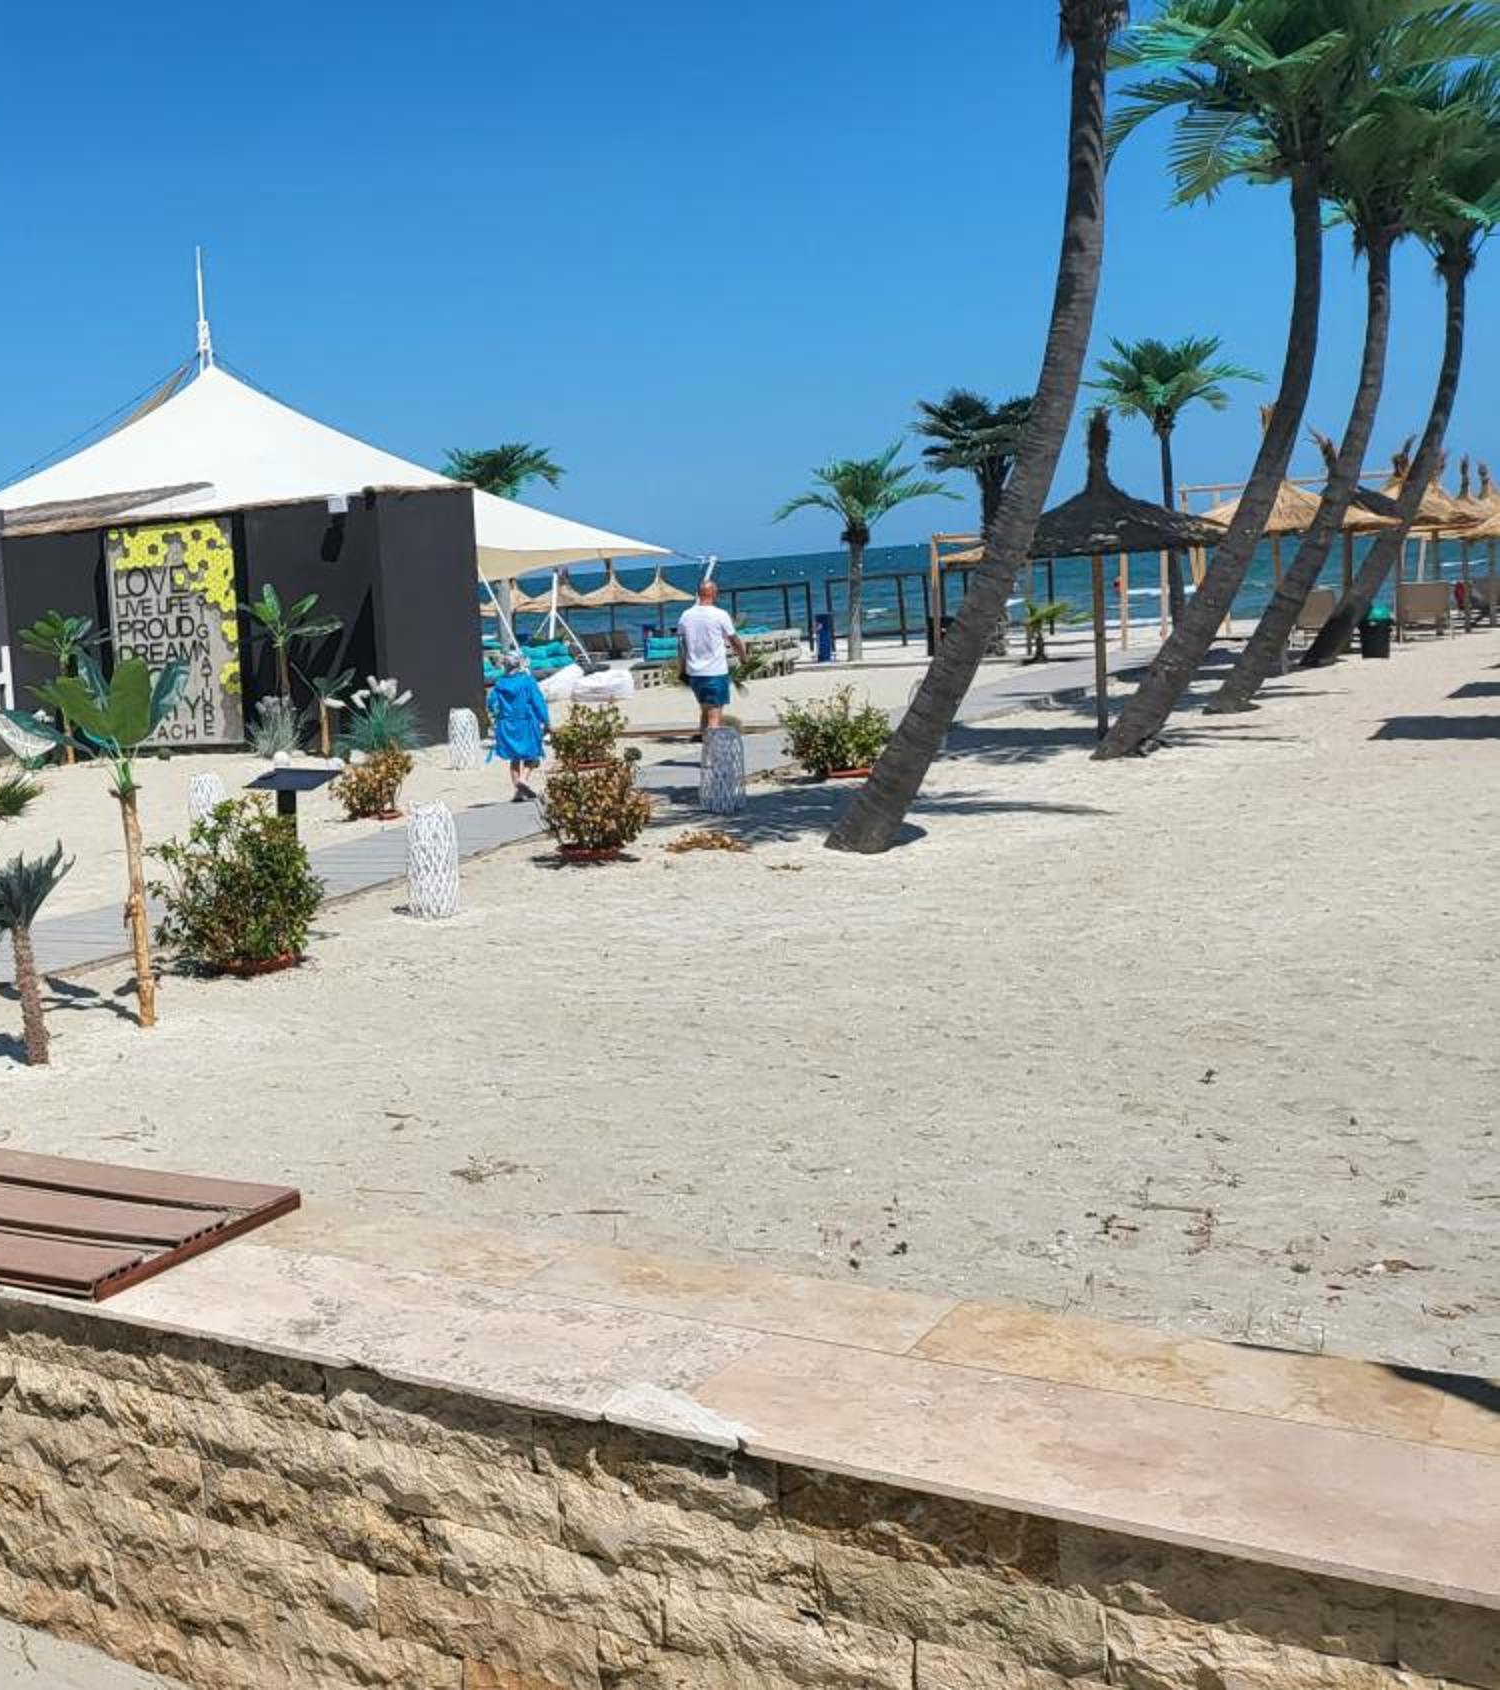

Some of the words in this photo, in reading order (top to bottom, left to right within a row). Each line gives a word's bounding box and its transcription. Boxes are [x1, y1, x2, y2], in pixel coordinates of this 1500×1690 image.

[114, 566, 189, 599] LOVE
[116, 598, 153, 619] LIVE
[158, 596, 191, 615] LIFE
[118, 615, 195, 642] PROUD
[119, 640, 199, 665] DREAM
